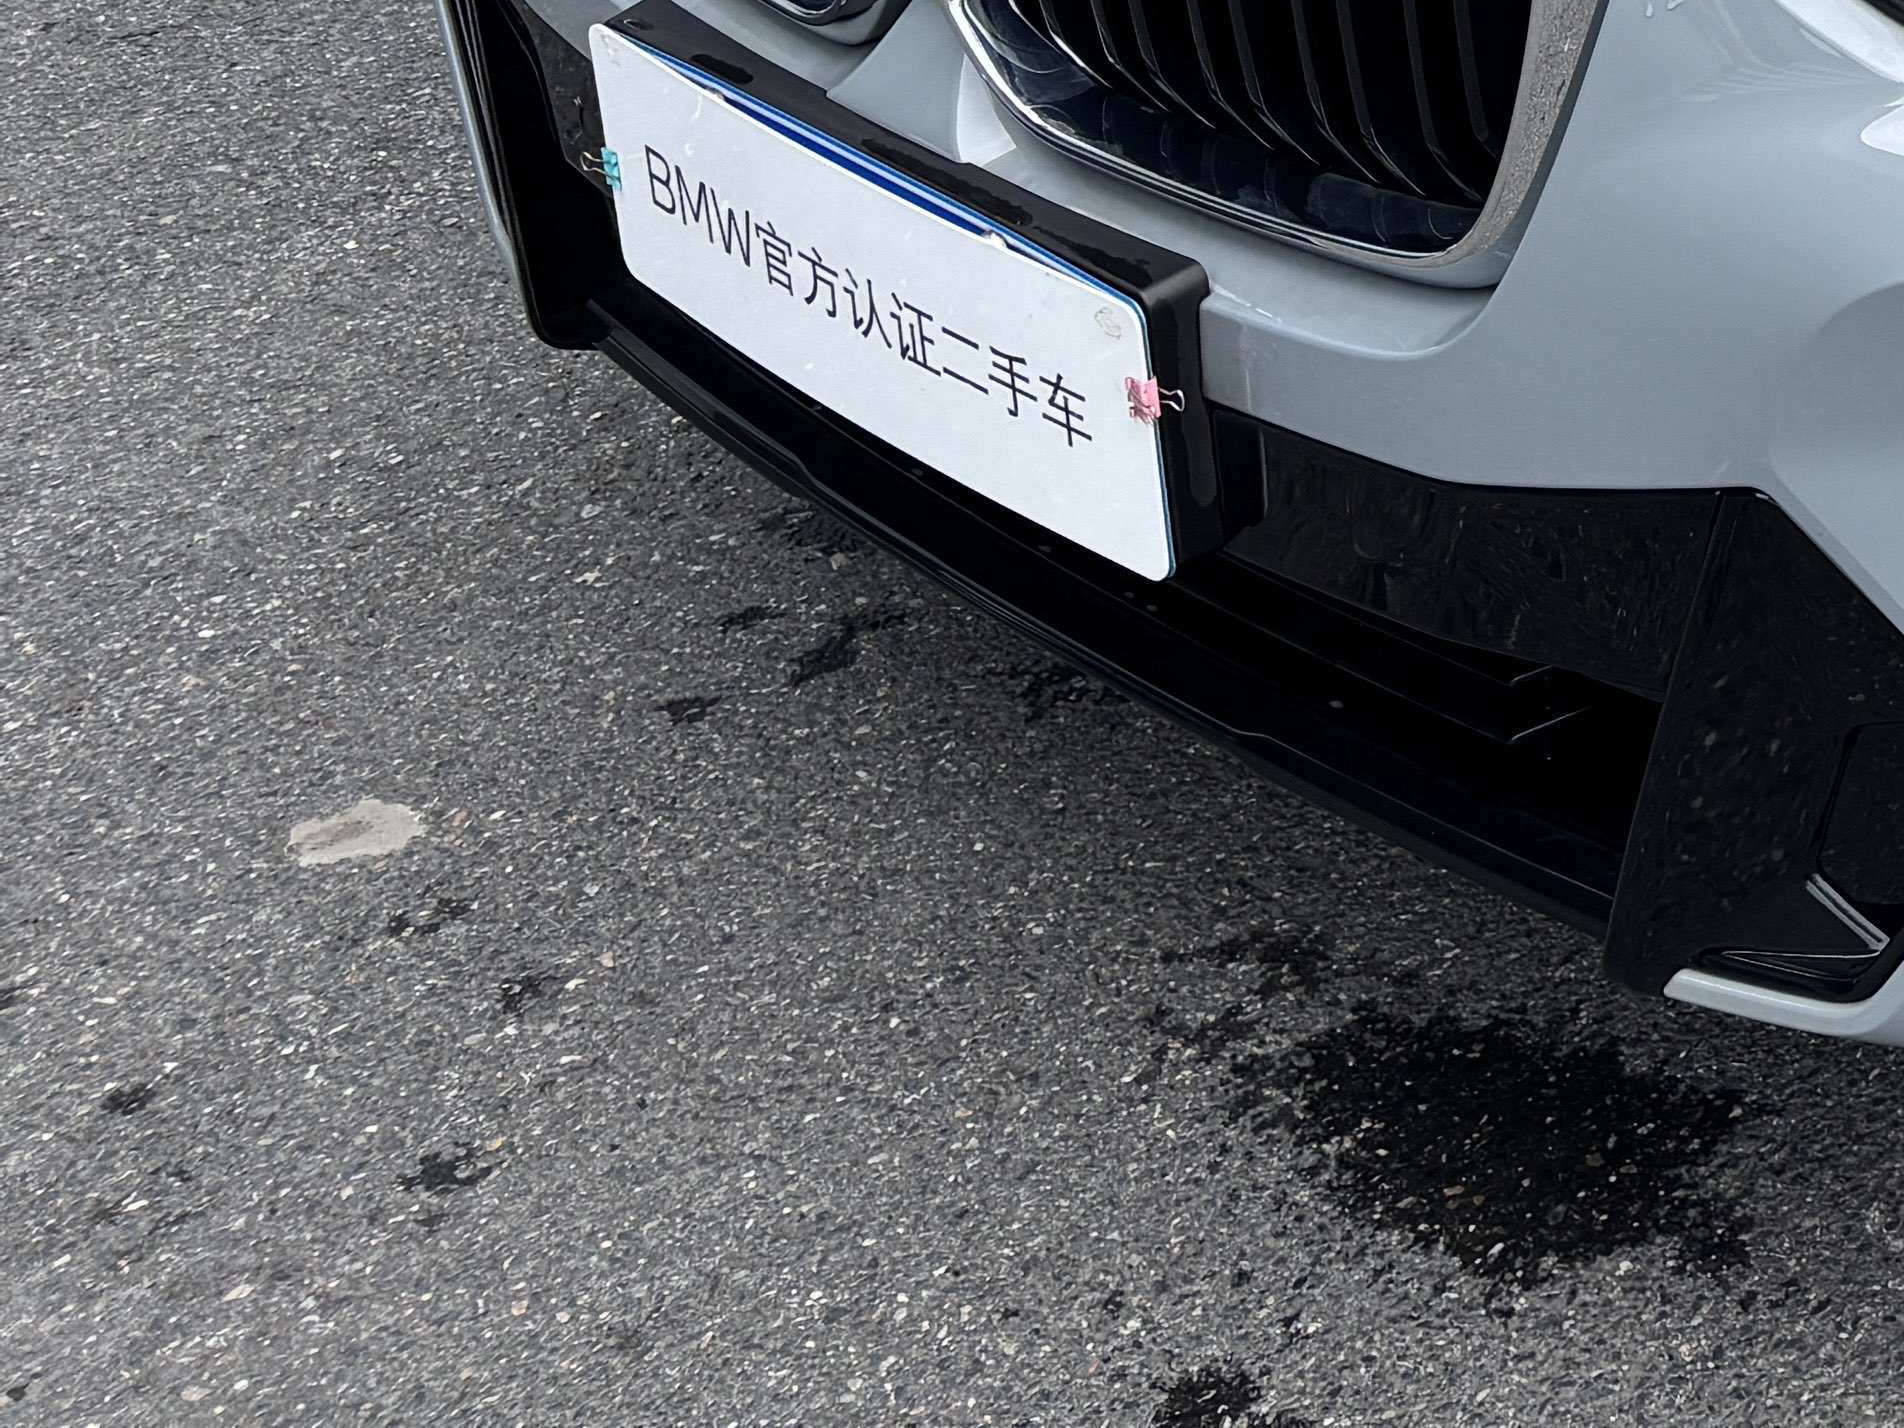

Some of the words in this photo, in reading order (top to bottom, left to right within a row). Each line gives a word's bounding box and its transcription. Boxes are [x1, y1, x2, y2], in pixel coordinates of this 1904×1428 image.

[643, 144, 1093, 448] BMW官方认证二手车
